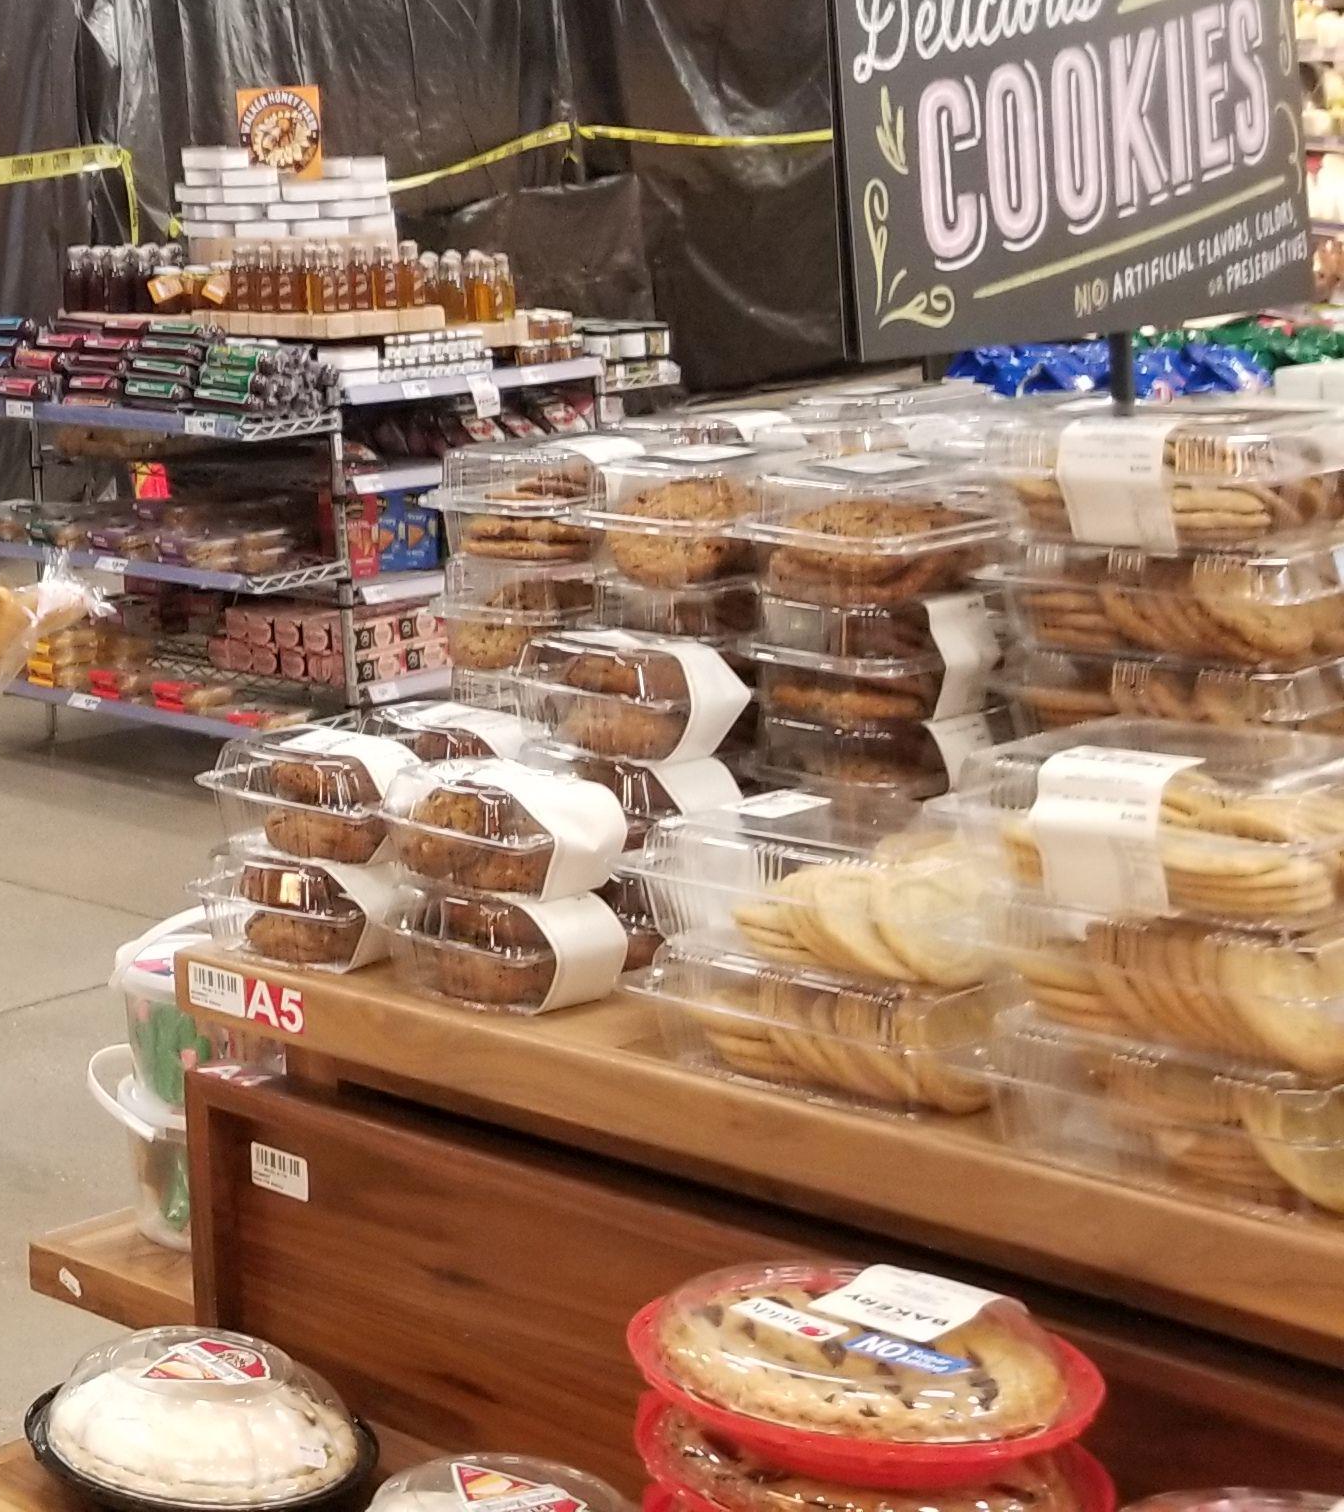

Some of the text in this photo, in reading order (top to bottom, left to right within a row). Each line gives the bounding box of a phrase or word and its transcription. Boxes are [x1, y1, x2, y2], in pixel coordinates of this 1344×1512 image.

[1112, 243, 1195, 304] ARTIFICIAL
[1198, 216, 1253, 267] FLAVORS,
[1255, 198, 1298, 242] COLORS,
[246, 978, 304, 1033] A5
[750, 1300, 810, 1328] Apple
[845, 1292, 950, 1327] BAKERY
[853, 1335, 909, 1358] NO
